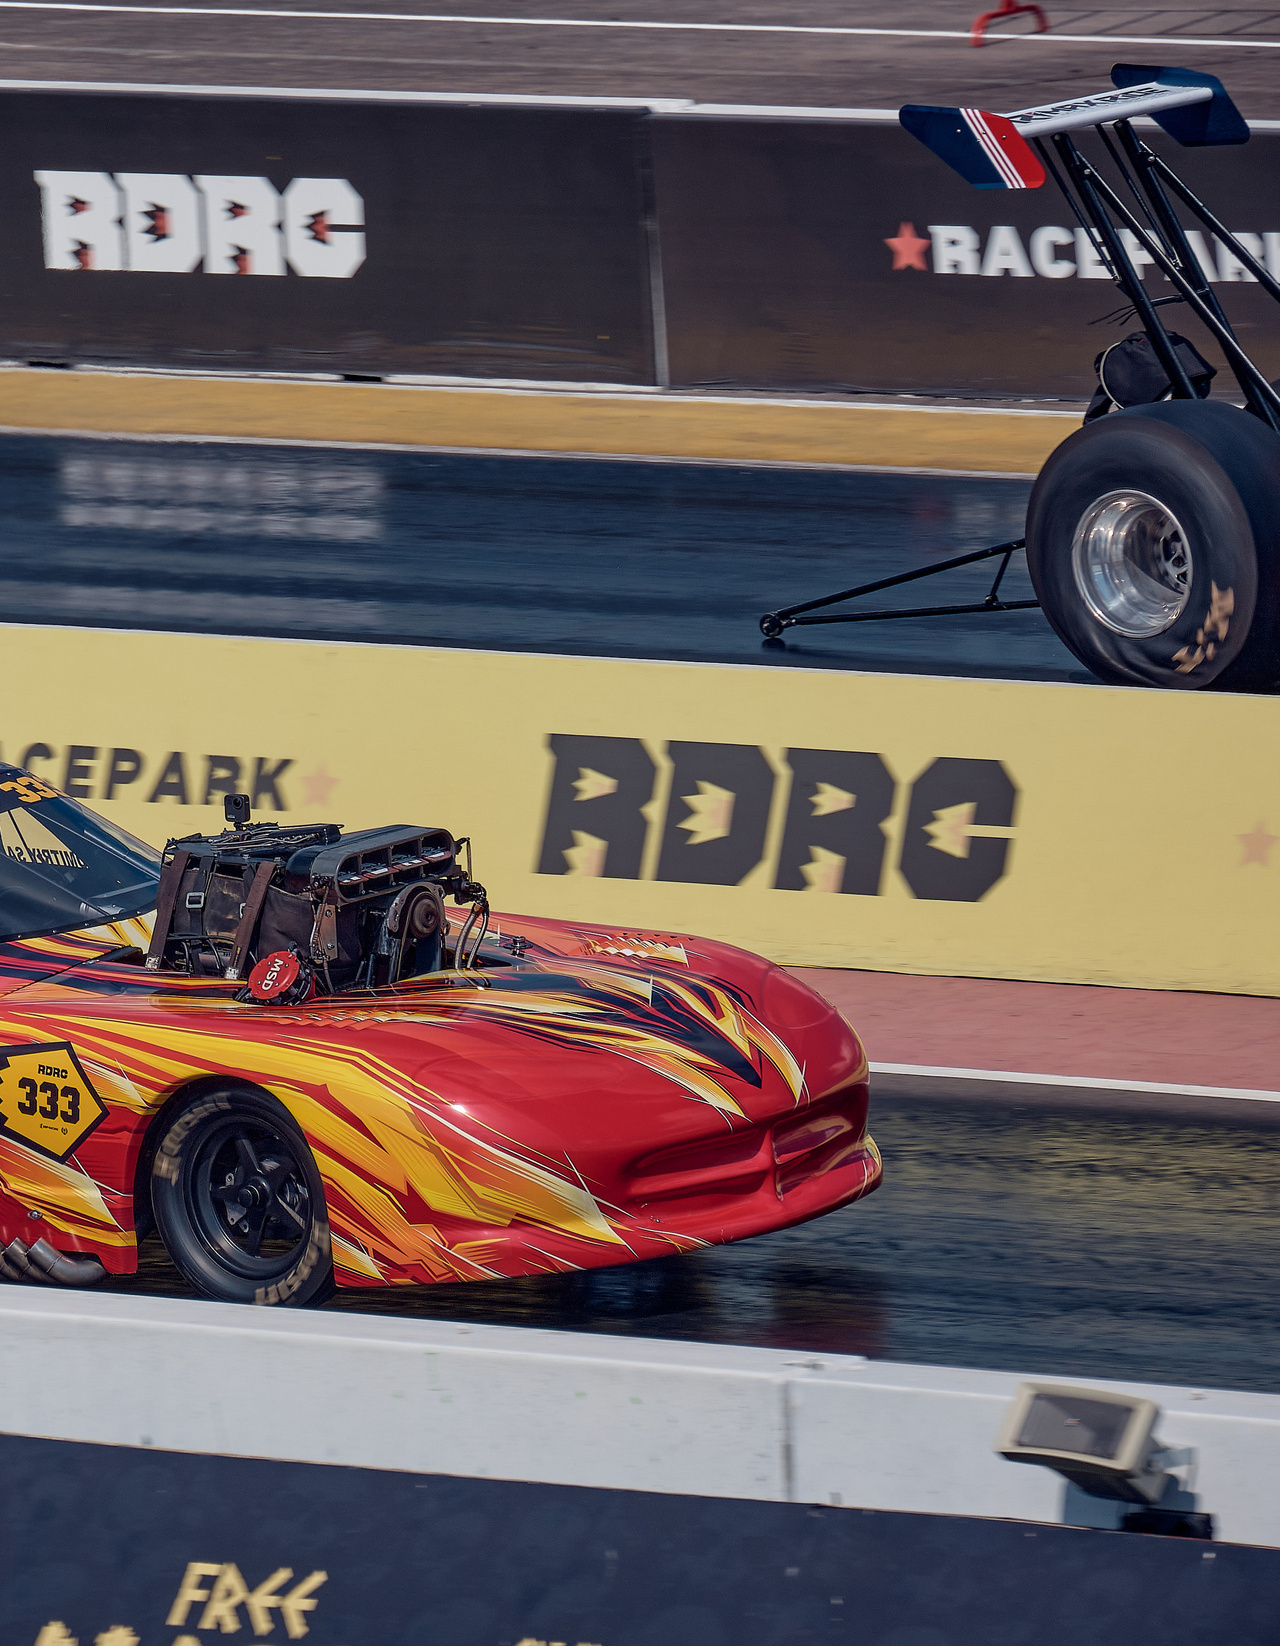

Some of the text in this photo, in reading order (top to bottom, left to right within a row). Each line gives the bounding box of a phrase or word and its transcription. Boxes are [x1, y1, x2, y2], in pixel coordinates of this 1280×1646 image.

[33, 169, 366, 278] RDRC
[532, 733, 1021, 902] RDRC
[261, 958, 284, 991] MSD
[17, 1076, 81, 1125] 333
[38, 1063, 69, 1079] RDRC
[165, 1562, 328, 1639] FREE
